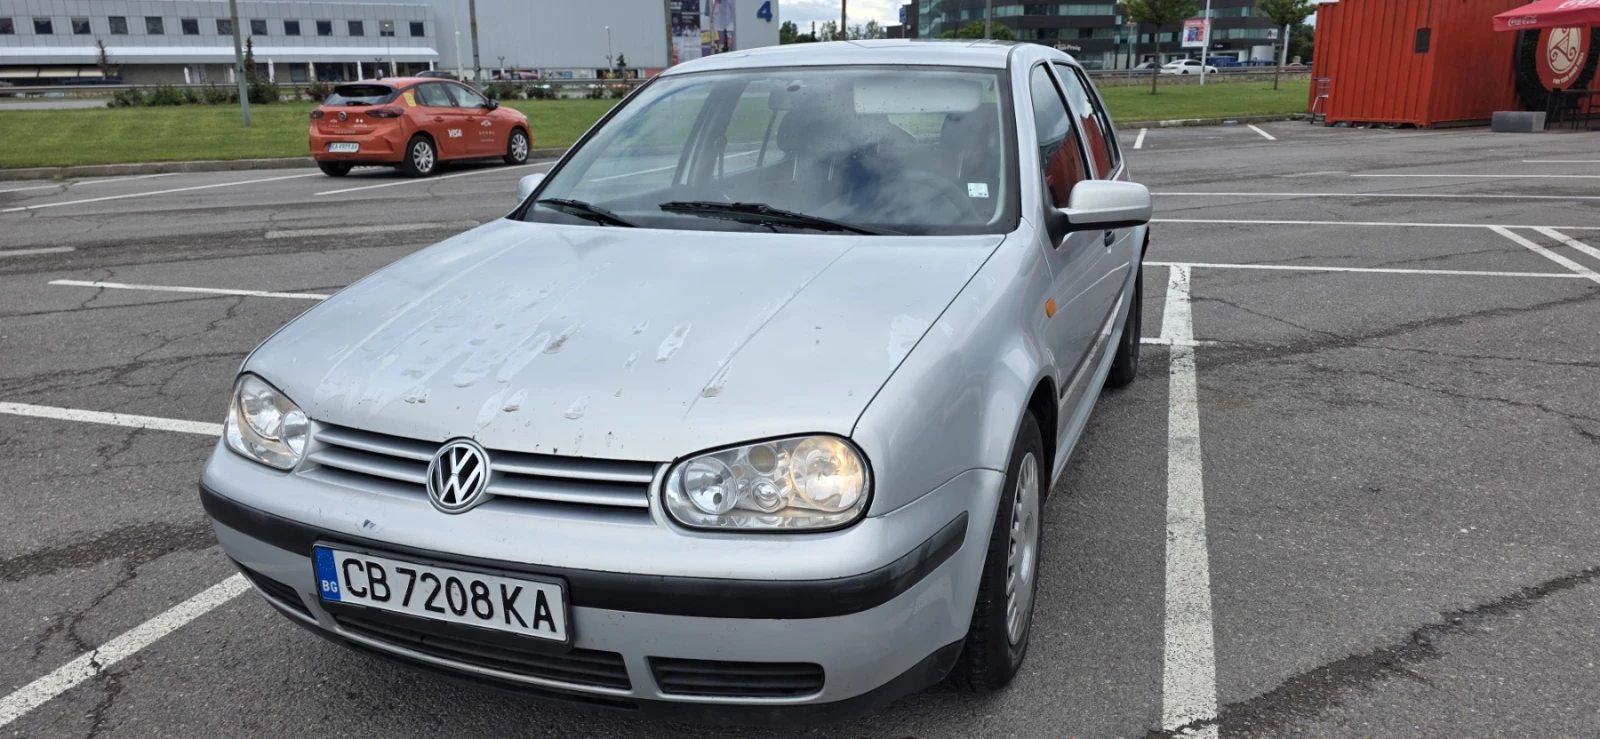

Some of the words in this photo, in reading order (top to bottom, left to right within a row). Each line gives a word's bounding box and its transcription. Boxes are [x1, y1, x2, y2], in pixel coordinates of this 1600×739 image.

[756, 0, 773, 22] 4
[447, 129, 463, 138] VISA
[321, 579, 339, 593] BG
